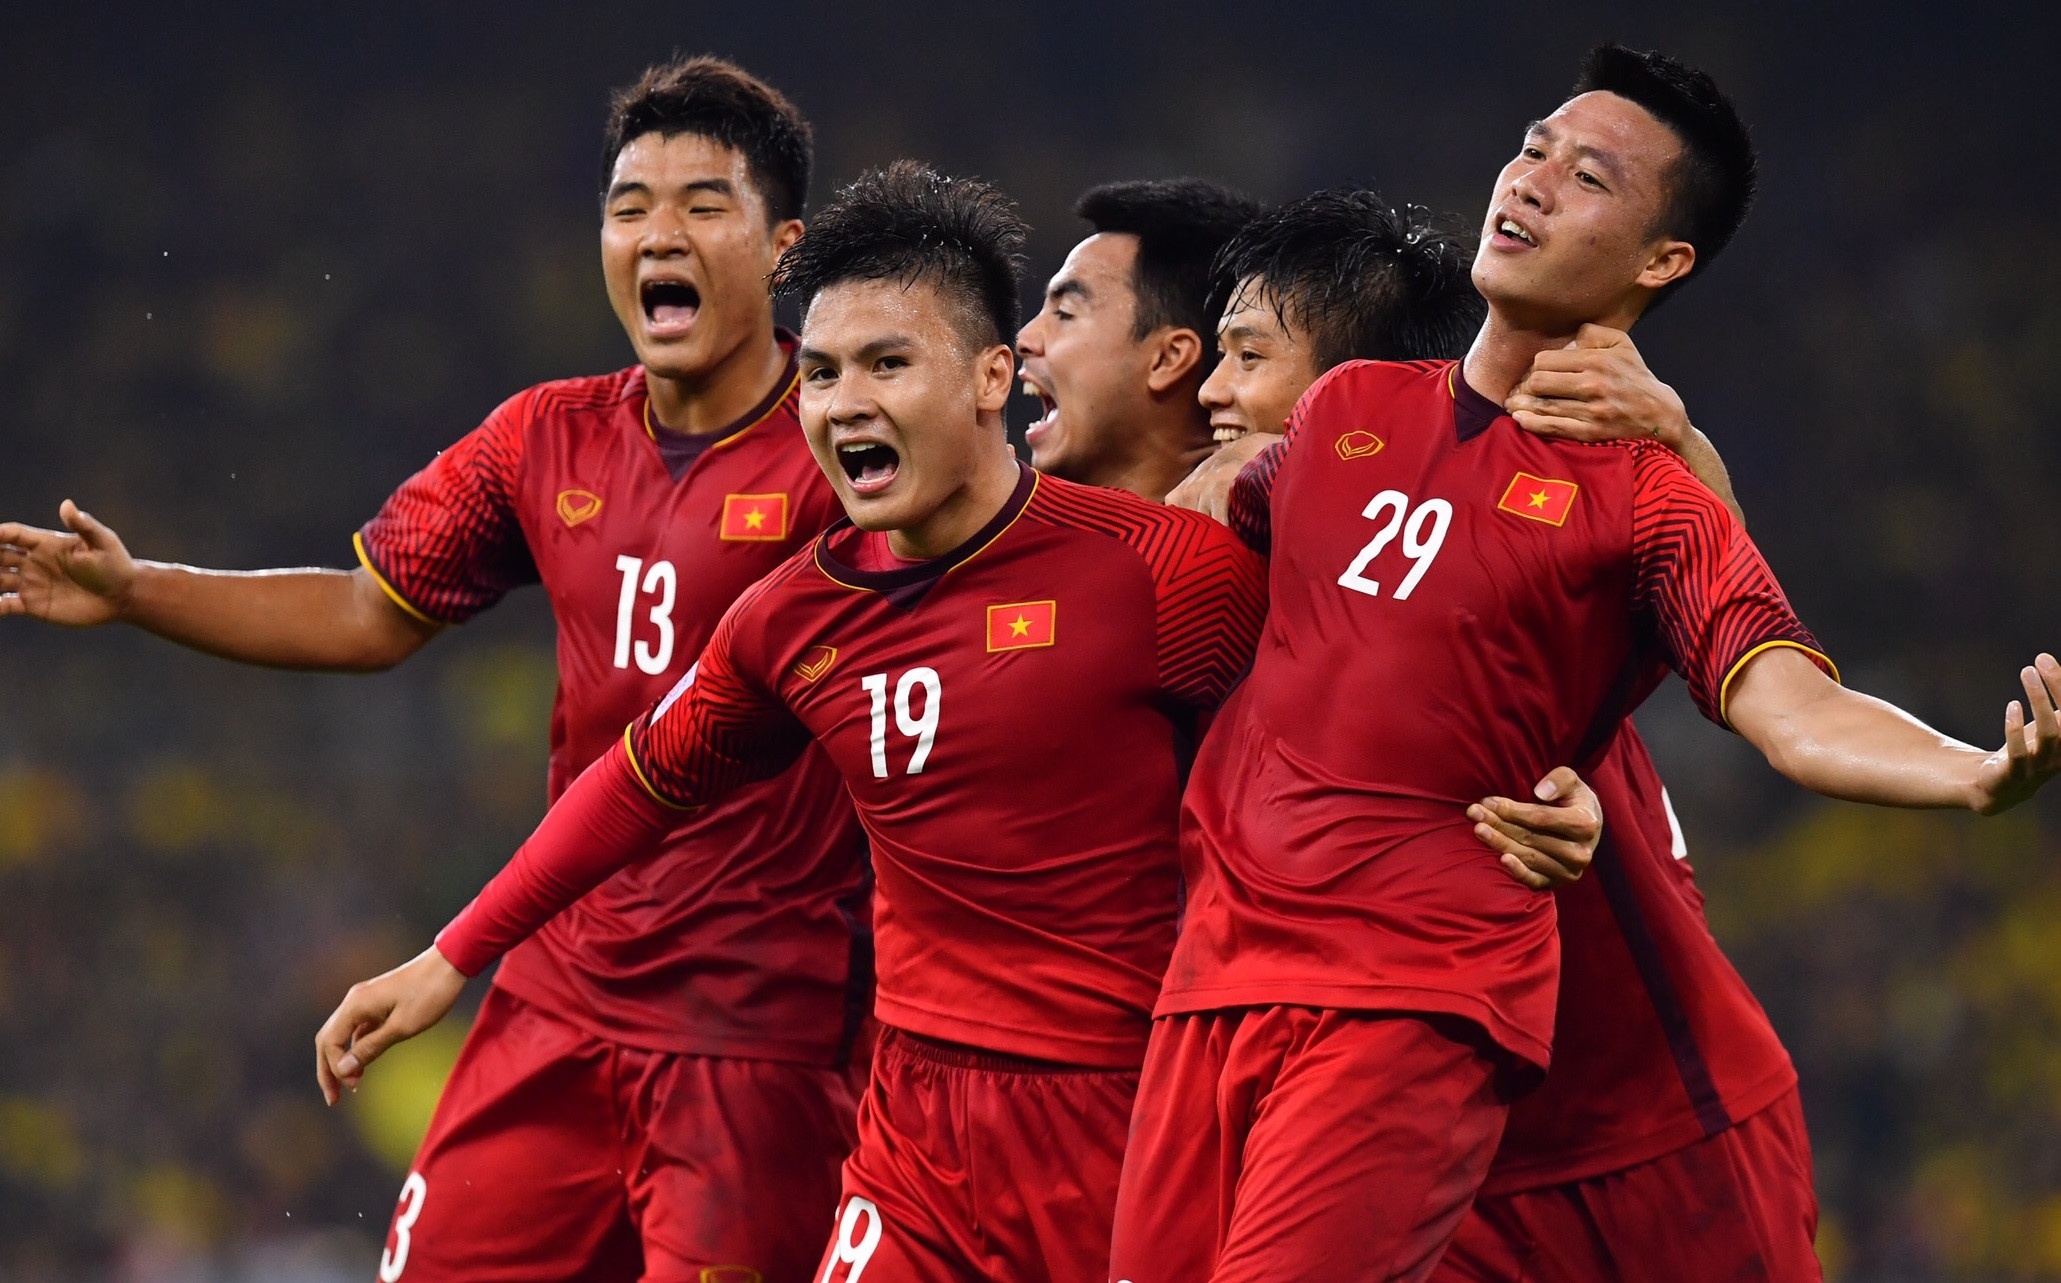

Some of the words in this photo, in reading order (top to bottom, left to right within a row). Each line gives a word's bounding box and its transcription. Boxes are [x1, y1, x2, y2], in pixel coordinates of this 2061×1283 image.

[1337, 489, 1454, 601] 29
[613, 554, 677, 675] 13
[861, 666, 942, 778] 19
